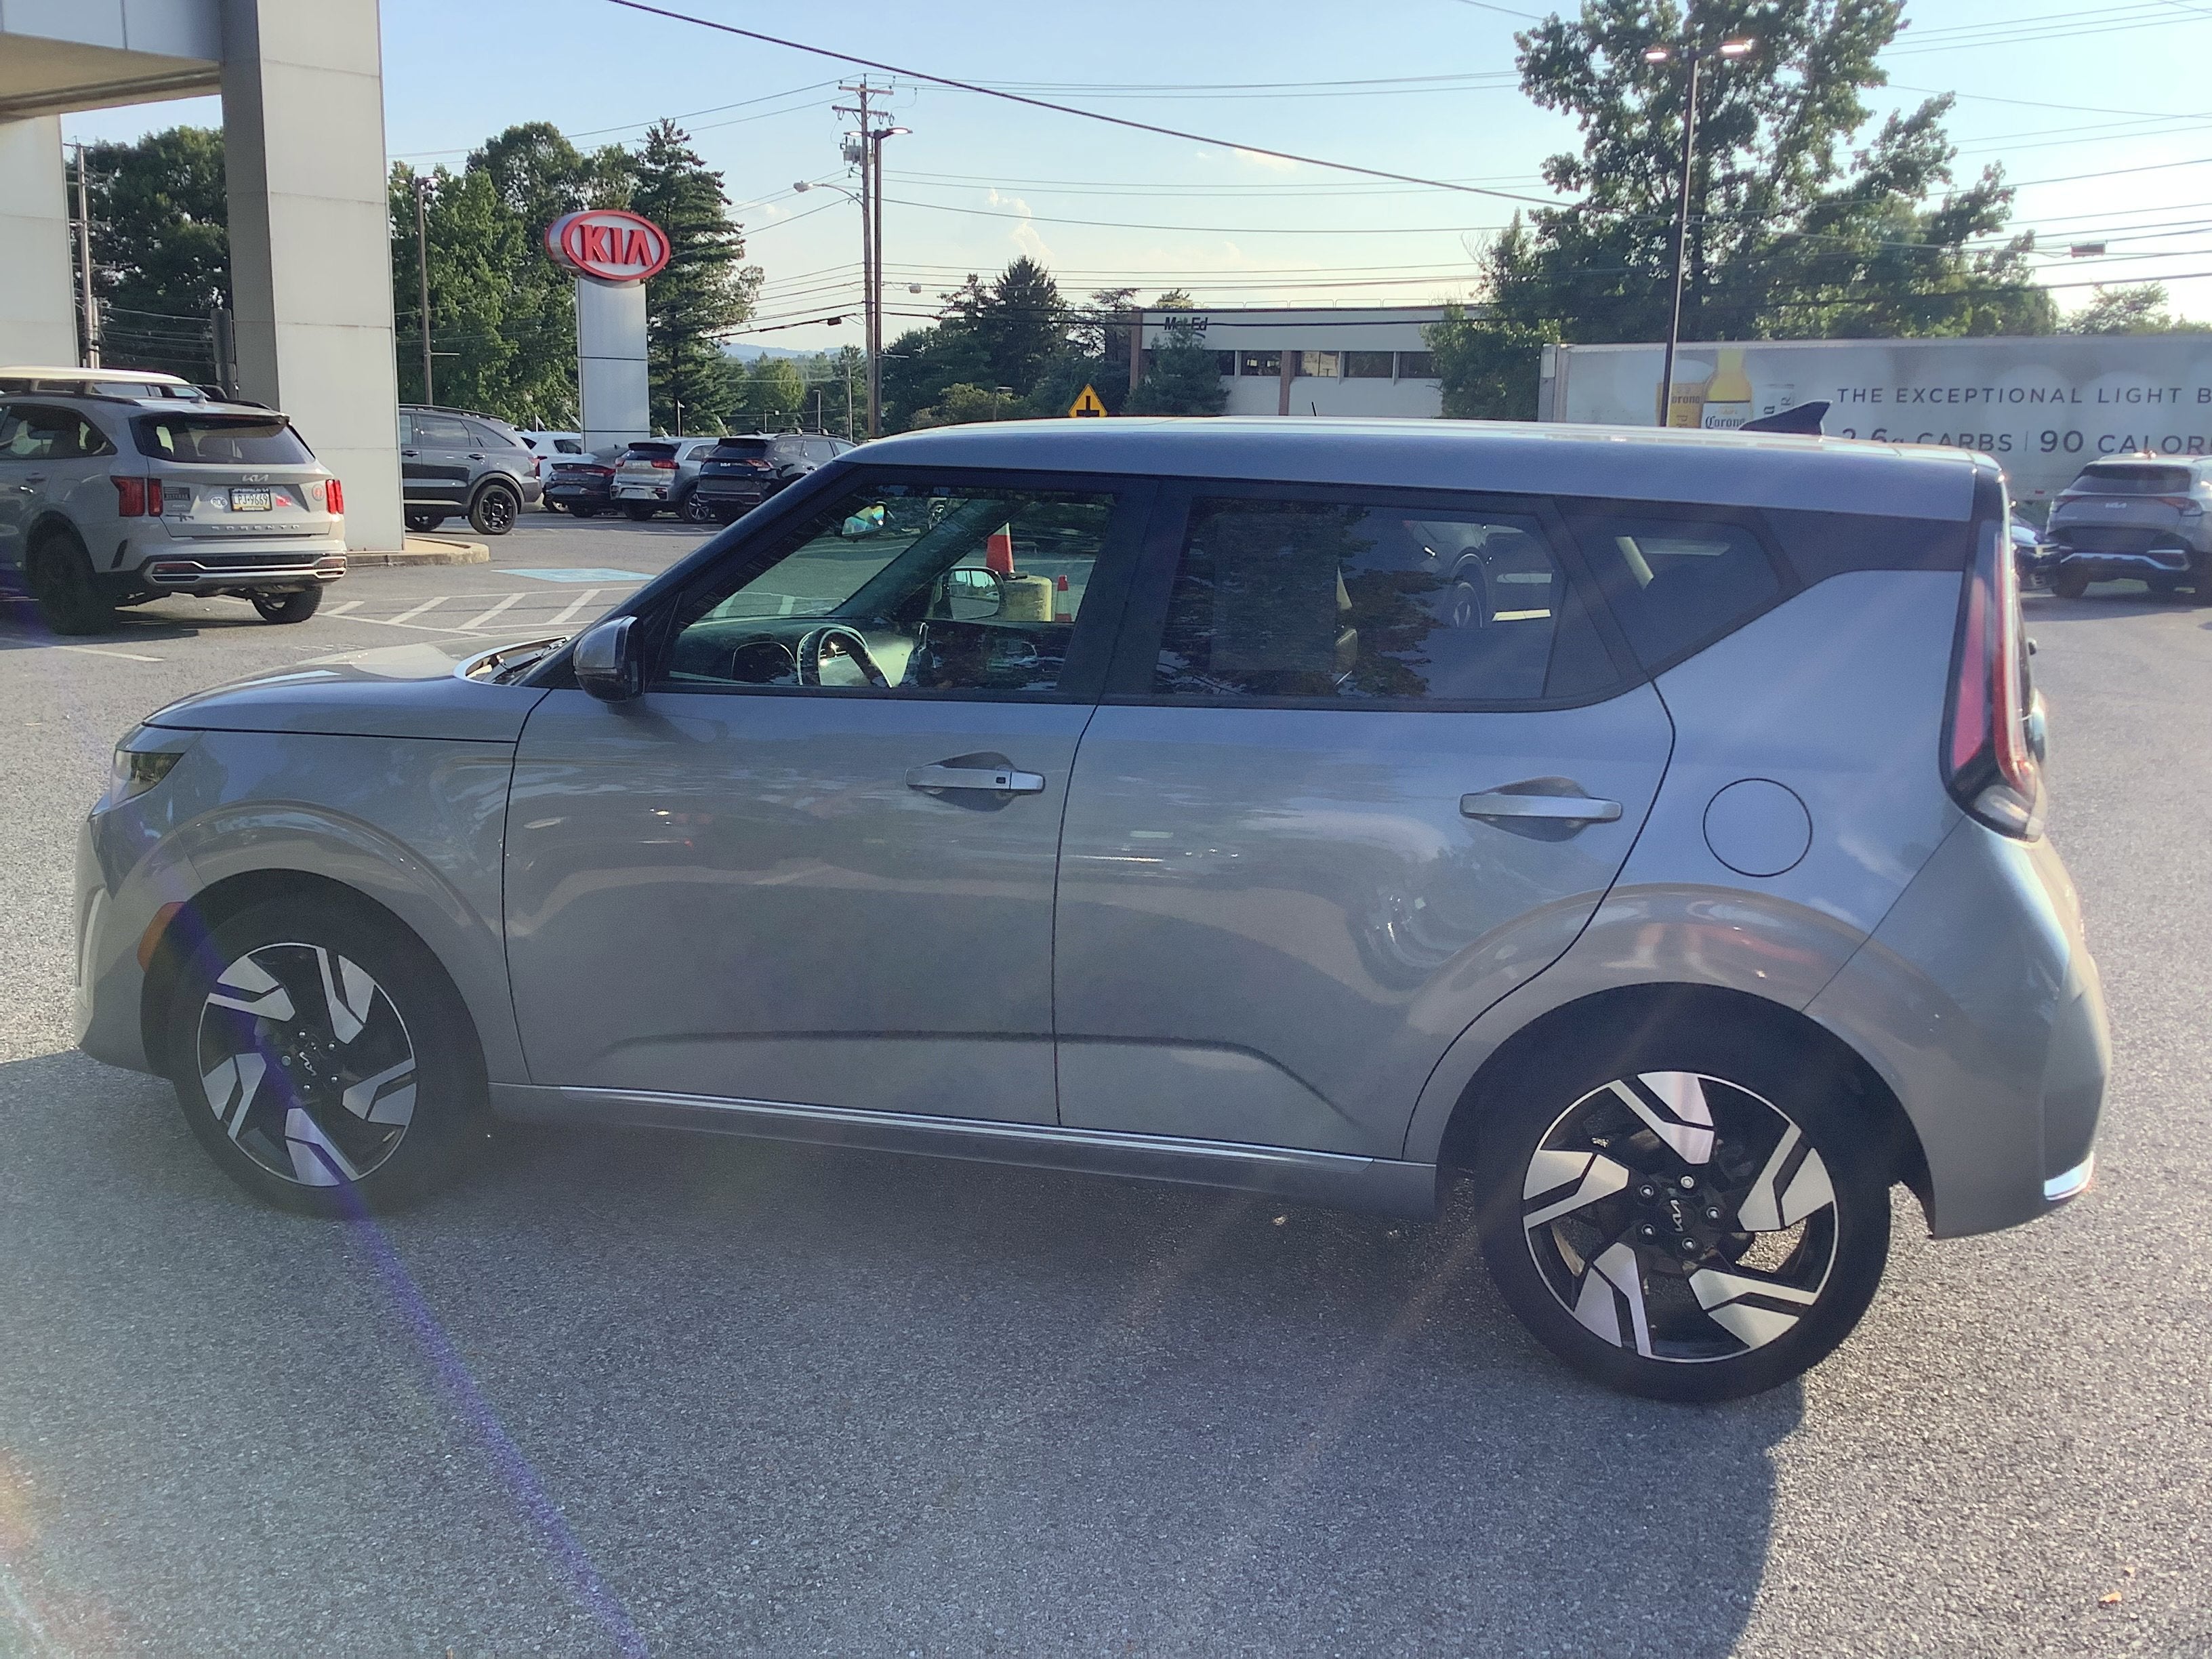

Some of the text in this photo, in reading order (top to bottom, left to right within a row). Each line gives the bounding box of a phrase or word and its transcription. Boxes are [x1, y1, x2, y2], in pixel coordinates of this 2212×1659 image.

[579, 224, 655, 266] KIA
[1671, 395, 1700, 404] orona
[1837, 388, 1883, 403] THE
[1896, 388, 2083, 403] EXCEPTIONAL
[2098, 388, 2182, 404] LIGHT
[1917, 432, 2013, 452] CARBS
[2039, 430, 2084, 453] 90
[2097, 435, 2212, 454] CALOR
